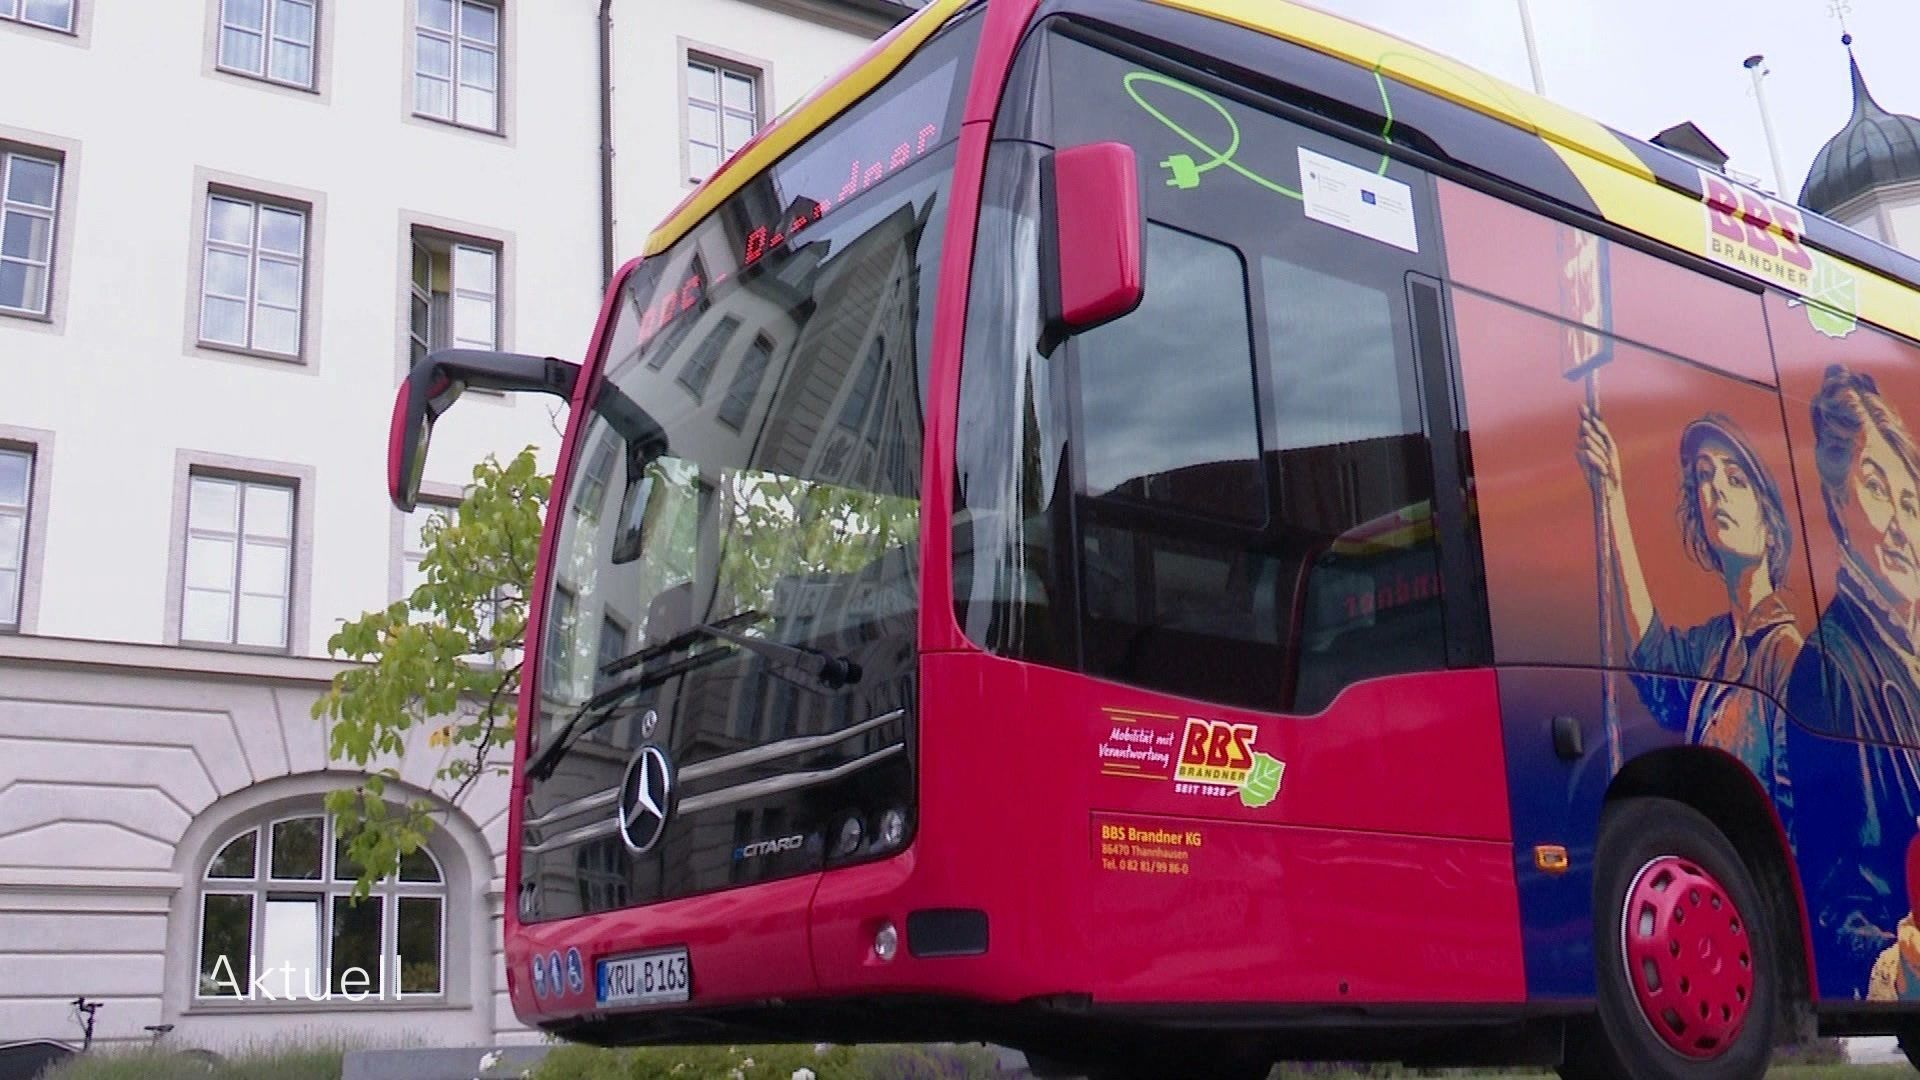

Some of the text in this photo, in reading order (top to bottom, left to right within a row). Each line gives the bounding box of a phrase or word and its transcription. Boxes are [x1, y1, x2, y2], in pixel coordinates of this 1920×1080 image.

[1707, 176, 1814, 271] BBS
[1711, 238, 1809, 286] BRANDNER
[1110, 727, 1175, 747] Mobilität mit
[1181, 722, 1254, 770] BBS
[1099, 743, 1169, 768] Verantwortung
[1178, 764, 1247, 781] BRANDNER
[1174, 783, 1200, 795] SEIT
[1101, 824, 1202, 847] BBS Brandner KG
[1102, 857, 1118, 870] Tel.
[1131, 845, 1188, 859] Thannhausen
[607, 961, 635, 998] KRU
